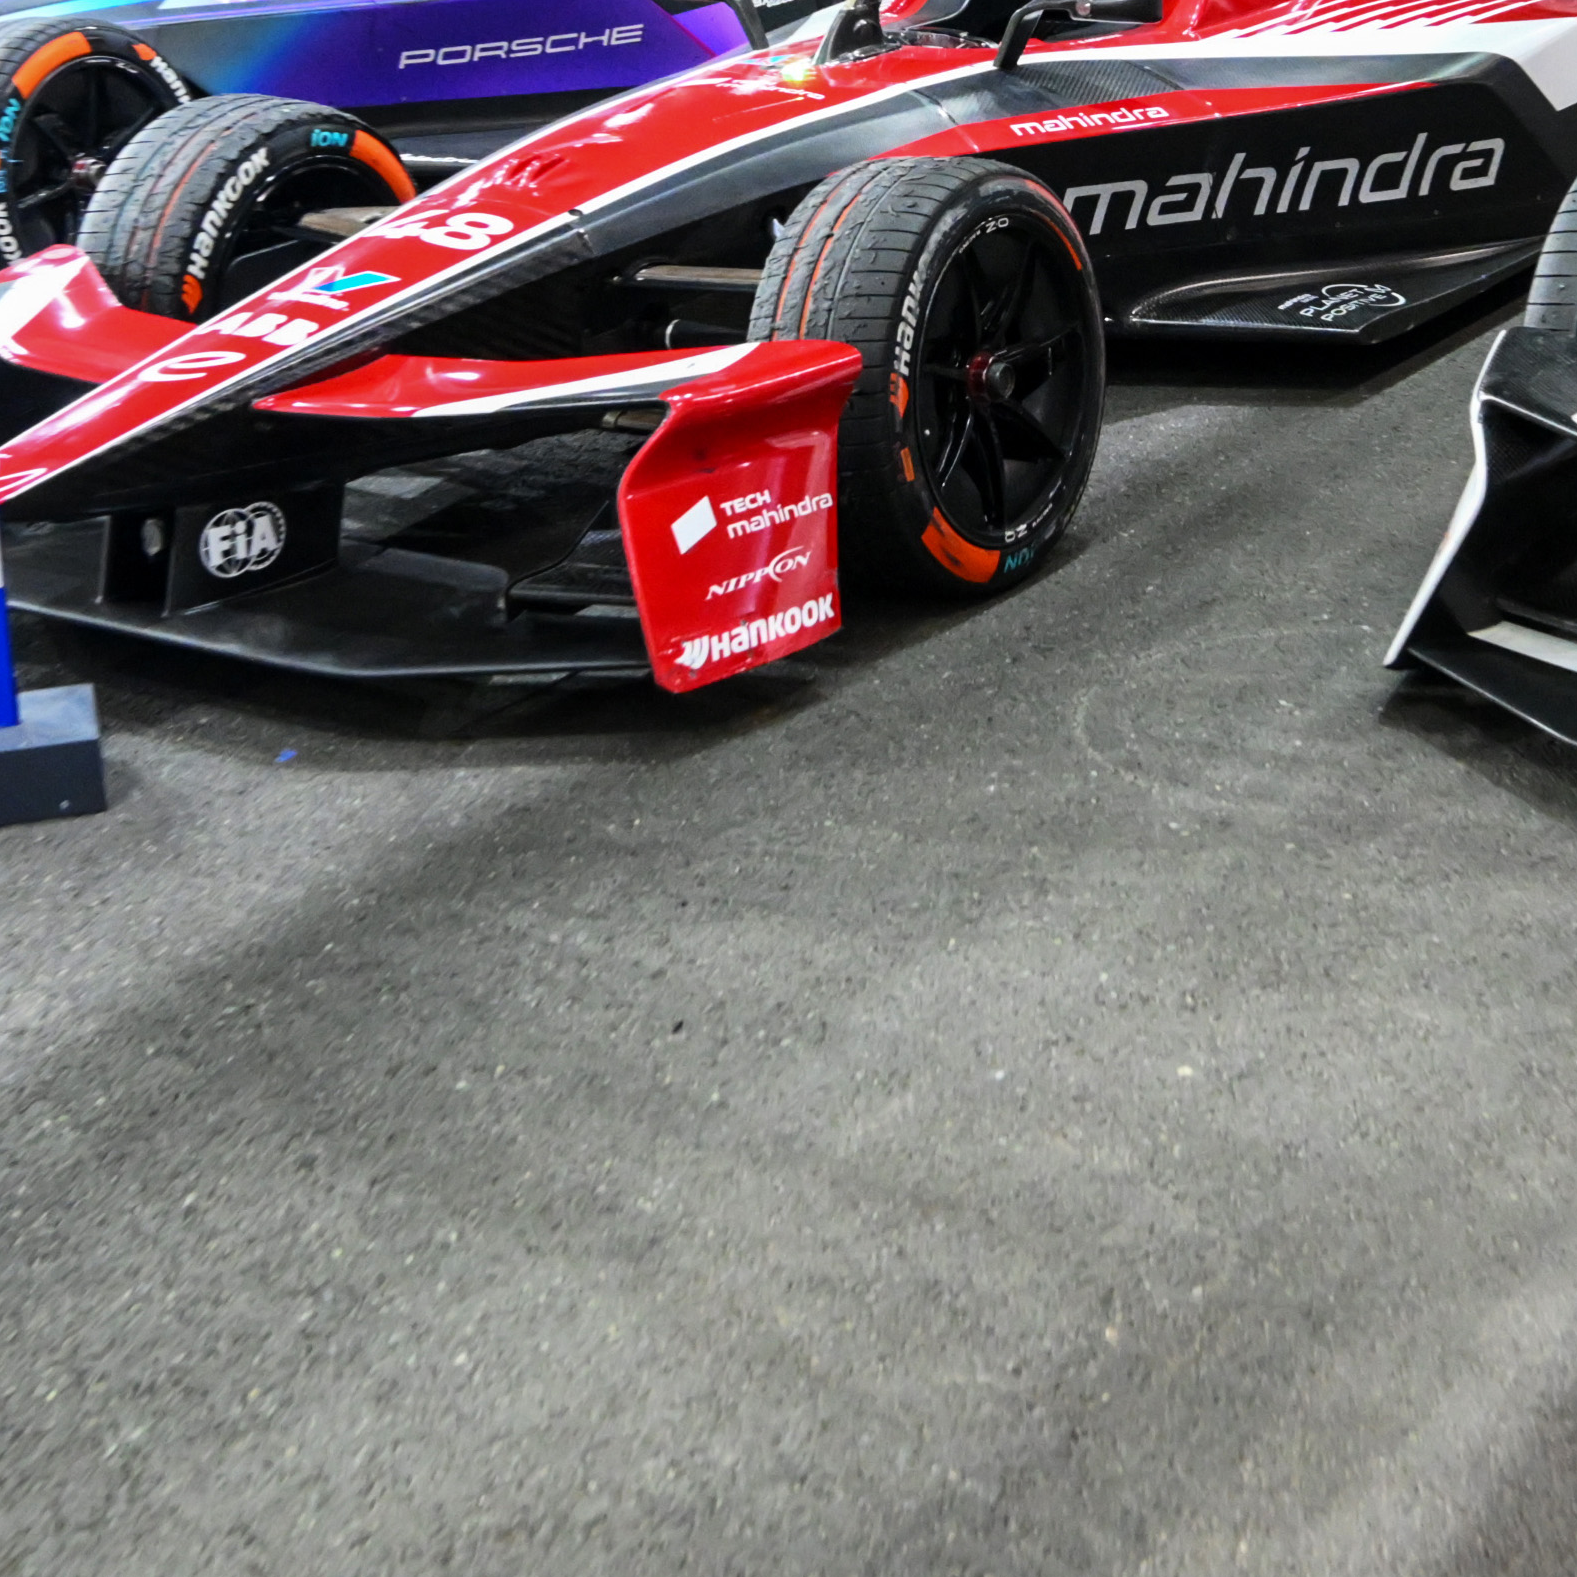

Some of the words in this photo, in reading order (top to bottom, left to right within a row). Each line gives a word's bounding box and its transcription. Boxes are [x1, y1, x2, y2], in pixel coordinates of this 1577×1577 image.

[398, 24, 646, 69] PORSCHE
[1010, 105, 1170, 138] mahindra
[1062, 133, 1506, 236] mahindra
[361, 208, 515, 251] 48
[199, 311, 321, 347] ABB
[720, 489, 772, 517] TECH
[726, 492, 834, 540] mahindra
[203, 509, 283, 564] FIA
[705, 547, 812, 601] NIPPON
